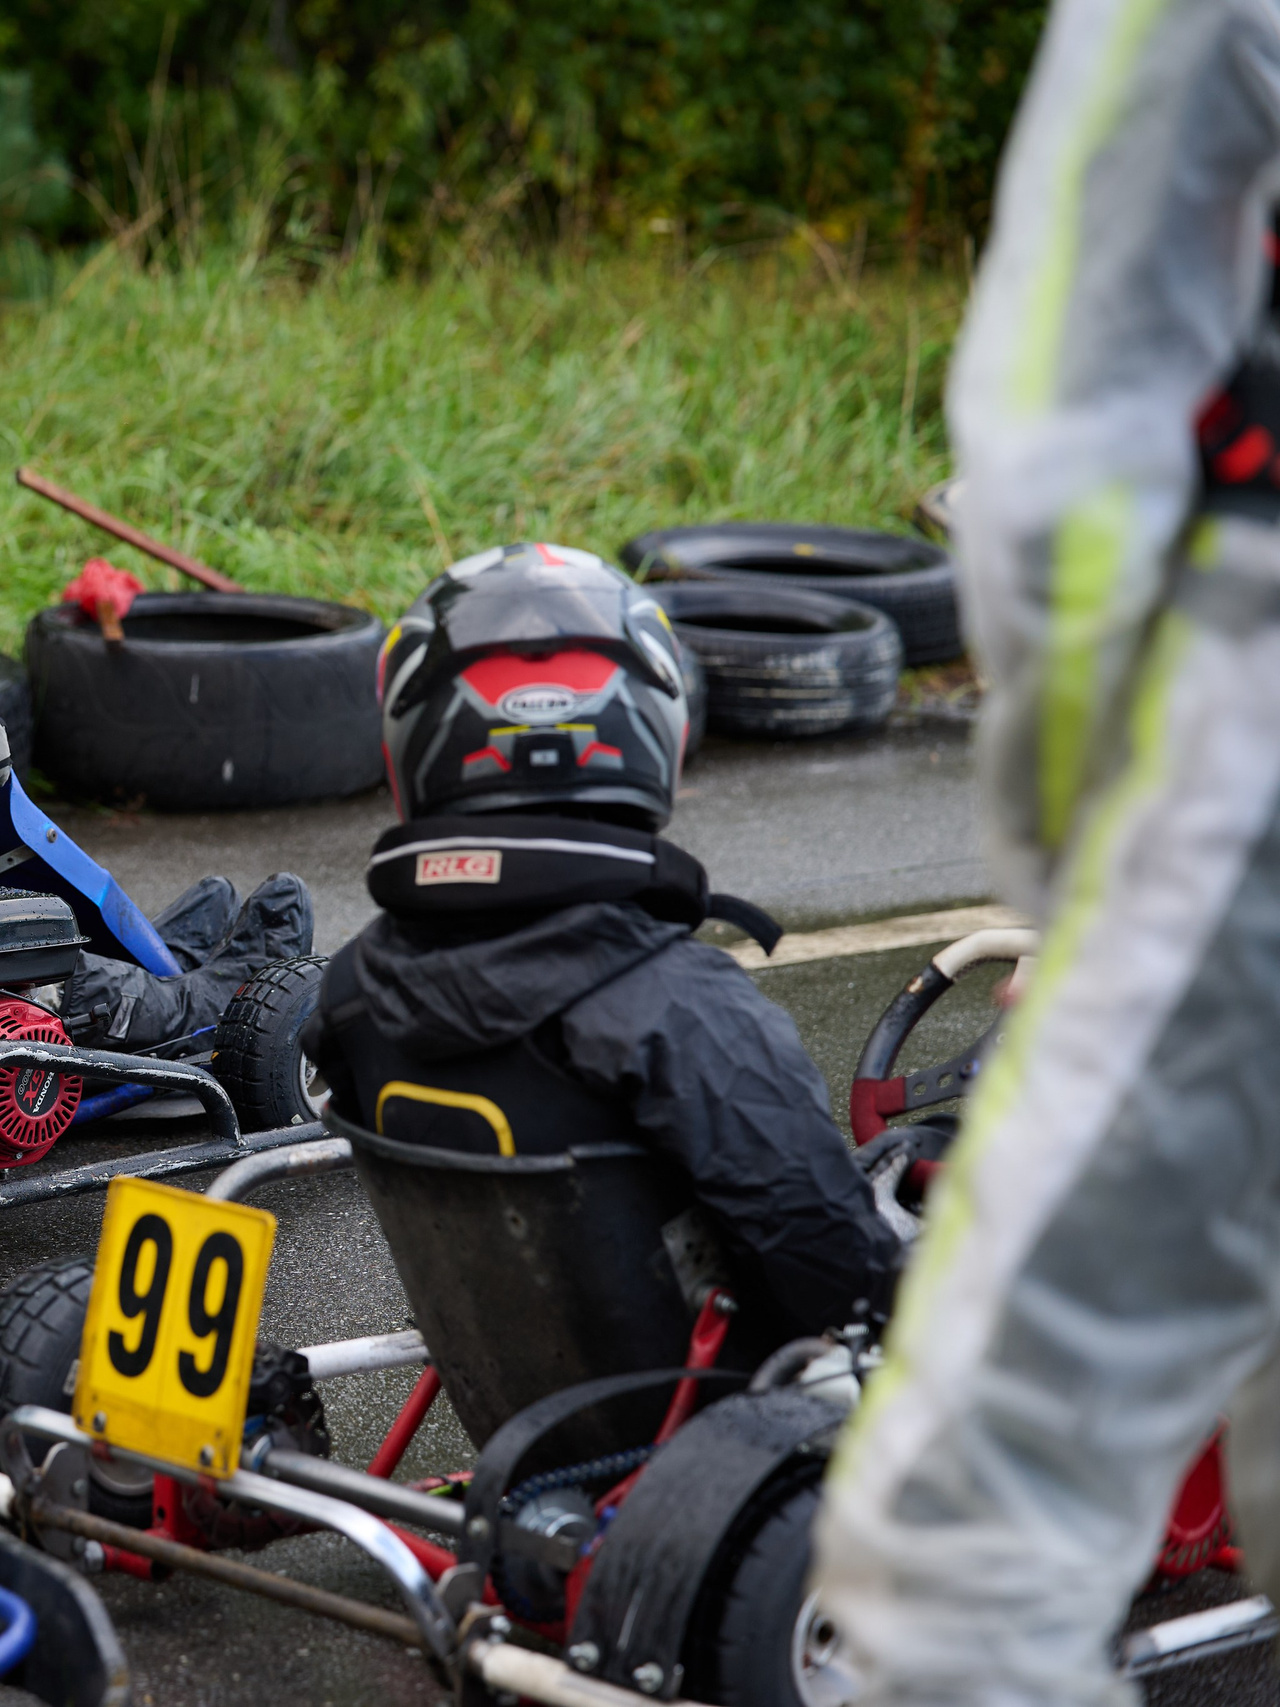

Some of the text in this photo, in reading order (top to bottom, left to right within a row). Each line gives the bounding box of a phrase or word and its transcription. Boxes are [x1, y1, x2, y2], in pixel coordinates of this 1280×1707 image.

[424, 857, 490, 877] RLG
[22, 1069, 45, 1108] GX
[32, 1071, 55, 1113] HONDA
[108, 1213, 244, 1398] 99
